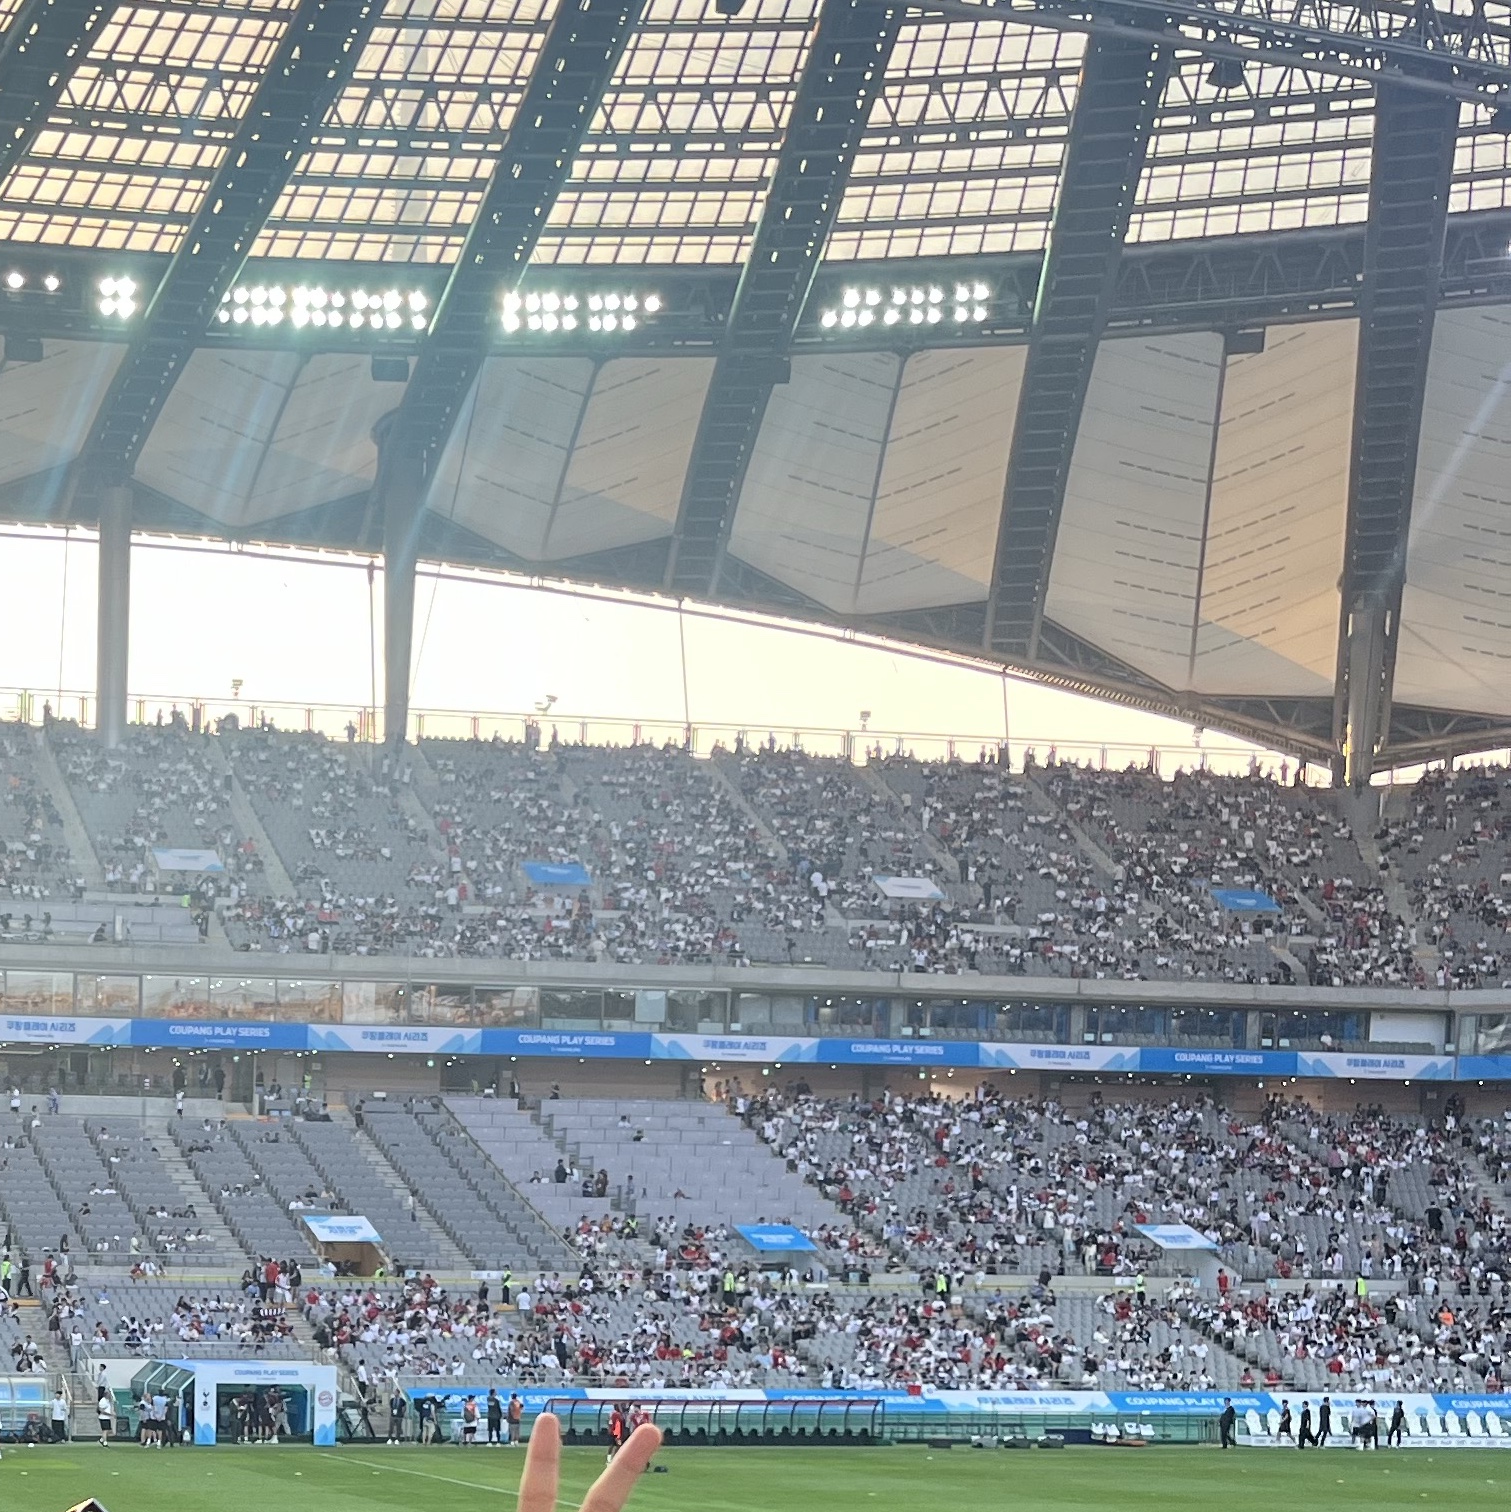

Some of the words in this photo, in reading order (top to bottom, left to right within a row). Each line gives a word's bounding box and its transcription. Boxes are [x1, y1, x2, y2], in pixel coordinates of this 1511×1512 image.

[169, 1026, 213, 1036] COUPANG
[214, 1026, 238, 1036] PLAY
[238, 1028, 270, 1038] SERIES
[518, 1034, 560, 1044] COUPANG
[561, 1035, 584, 1045] PLAY
[584, 1036, 615, 1046] SERIES
[850, 1044, 892, 1053] COUPANG
[892, 1044, 914, 1054] PLAY
[914, 1044, 944, 1054] SERIES
[1174, 1052, 1213, 1062] COUPANG
[1214, 1054, 1235, 1063] PLAY
[1235, 1054, 1263, 1064] SERIES
[279, 1370, 299, 1378] SERIES
[1125, 1397, 1186, 1406] COUPANG
[1186, 1398, 1216, 1406] PLAY
[1216, 1398, 1260, 1406] SRIES
[1452, 1399, 1508, 1408] COUPANG
